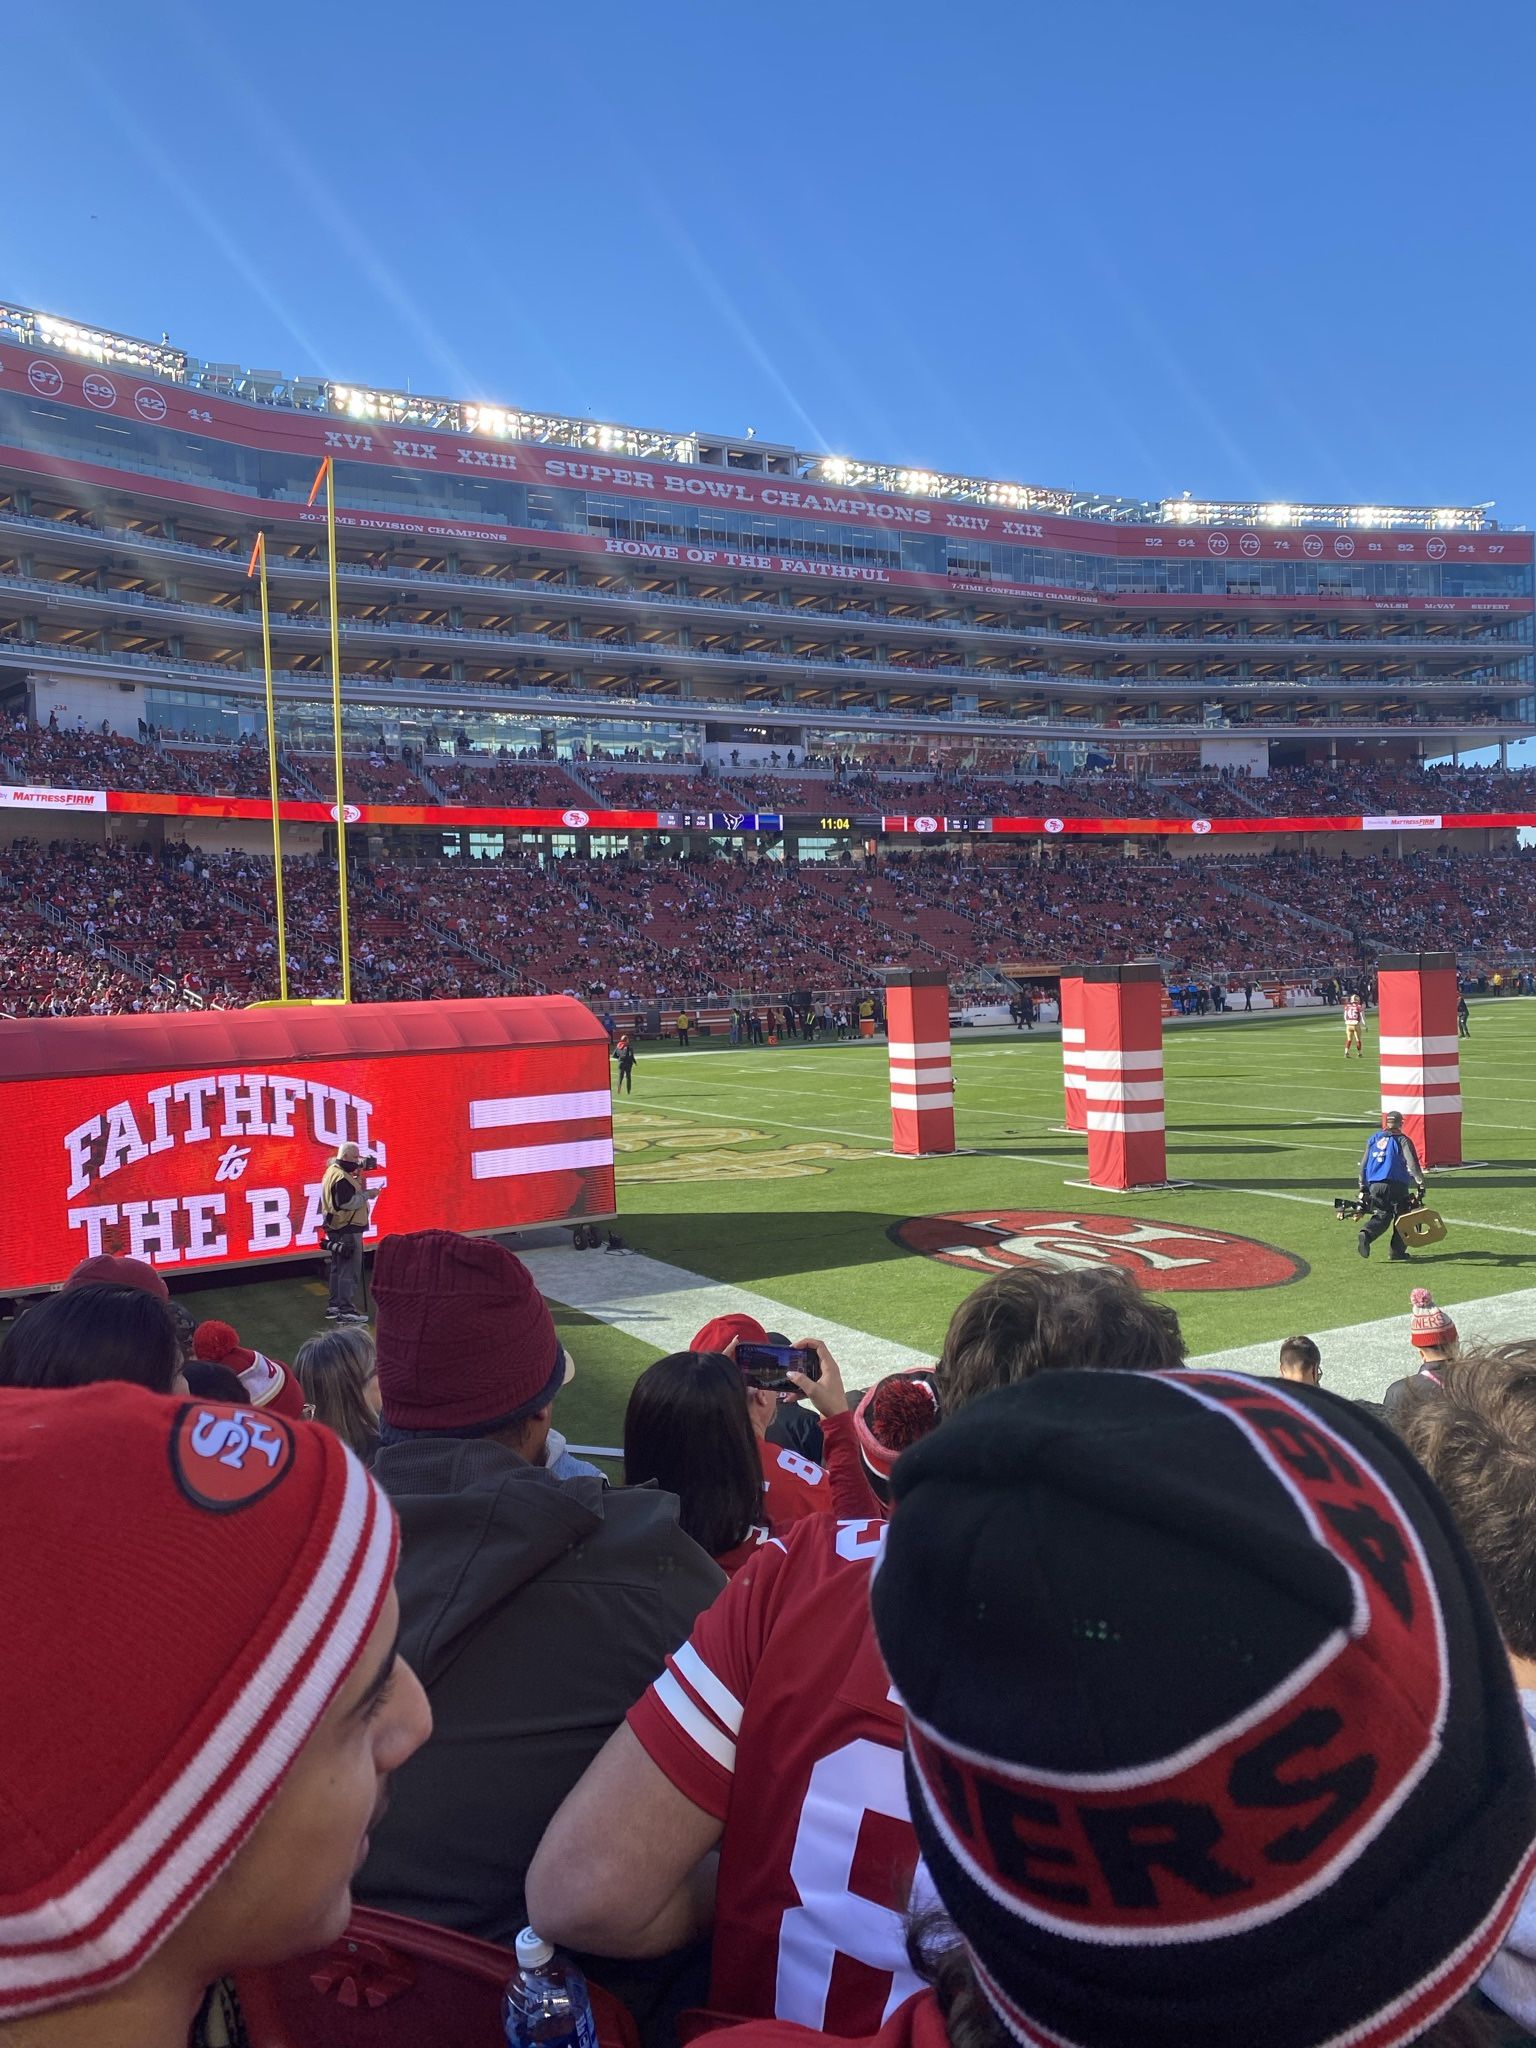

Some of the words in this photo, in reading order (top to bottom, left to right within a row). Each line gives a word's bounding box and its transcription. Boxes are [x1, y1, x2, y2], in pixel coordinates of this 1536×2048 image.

[31, 368, 59, 385] 37
[84, 381, 115, 399] 39
[137, 396, 165, 411] 42
[187, 408, 213, 423] 44
[324, 431, 373, 452] XVI
[393, 440, 438, 460] XIX
[457, 449, 517, 470] XXIII
[545, 460, 655, 489] SUPER
[664, 475, 754, 501] BOWL
[761, 488, 932, 524] CHAMPIONS
[946, 513, 990, 531] XXIV
[1002, 521, 1043, 538] XXIX
[299, 512, 356, 525] 20-TME
[360, 519, 424, 533] DIVISION
[427, 526, 508, 542] CHAMPIONS
[604, 539, 679, 560] HOME
[686, 549, 718, 564] OF
[724, 552, 771, 569] THE
[780, 558, 890, 582] FAITHFUL
[985, 586, 1044, 598] CONFERENCE
[1045, 592, 1098, 603] CHAMPIONS
[820, 818, 850, 830] 11:04
[64, 1074, 387, 1200] FAITHFUL
[214, 1144, 250, 1182] to
[68, 1191, 228, 1266] THE
[1412, 1313, 1445, 1329] NERS
